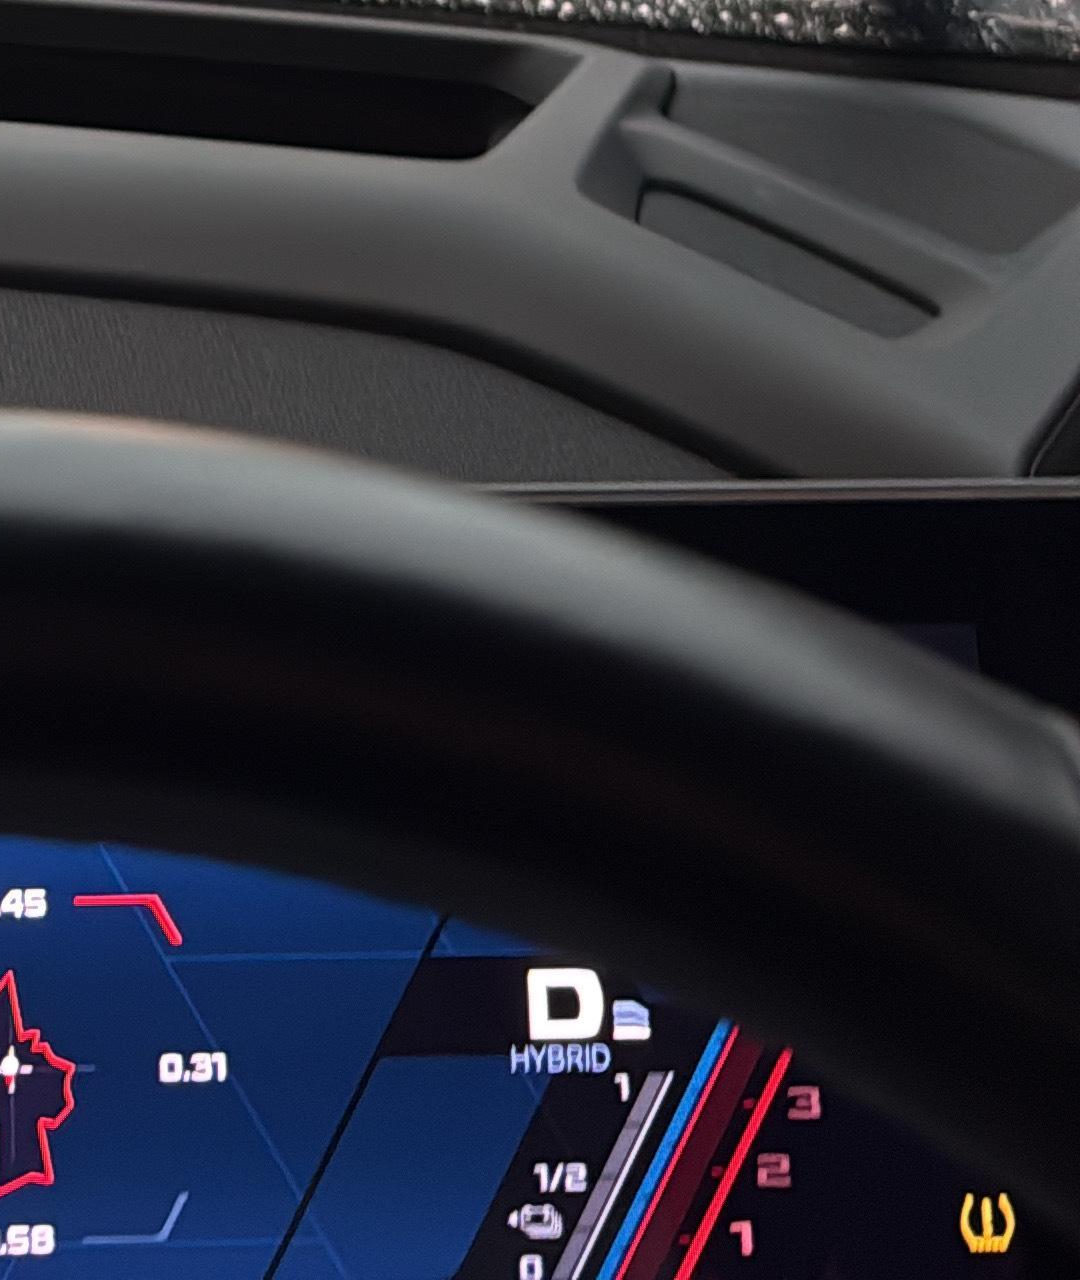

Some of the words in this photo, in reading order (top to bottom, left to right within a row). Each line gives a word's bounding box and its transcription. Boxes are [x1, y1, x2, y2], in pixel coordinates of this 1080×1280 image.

[528, 968, 605, 1040] D
[159, 1051, 228, 1084] 0.31
[510, 1043, 612, 1074] HYBRID
[615, 1072, 630, 1102] 1
[787, 1086, 821, 1120] 3
[533, 1162, 588, 1192] 1/2
[757, 1152, 791, 1188] 2
[730, 1220, 753, 1257] 1
[520, 1254, 544, 1280] 0
